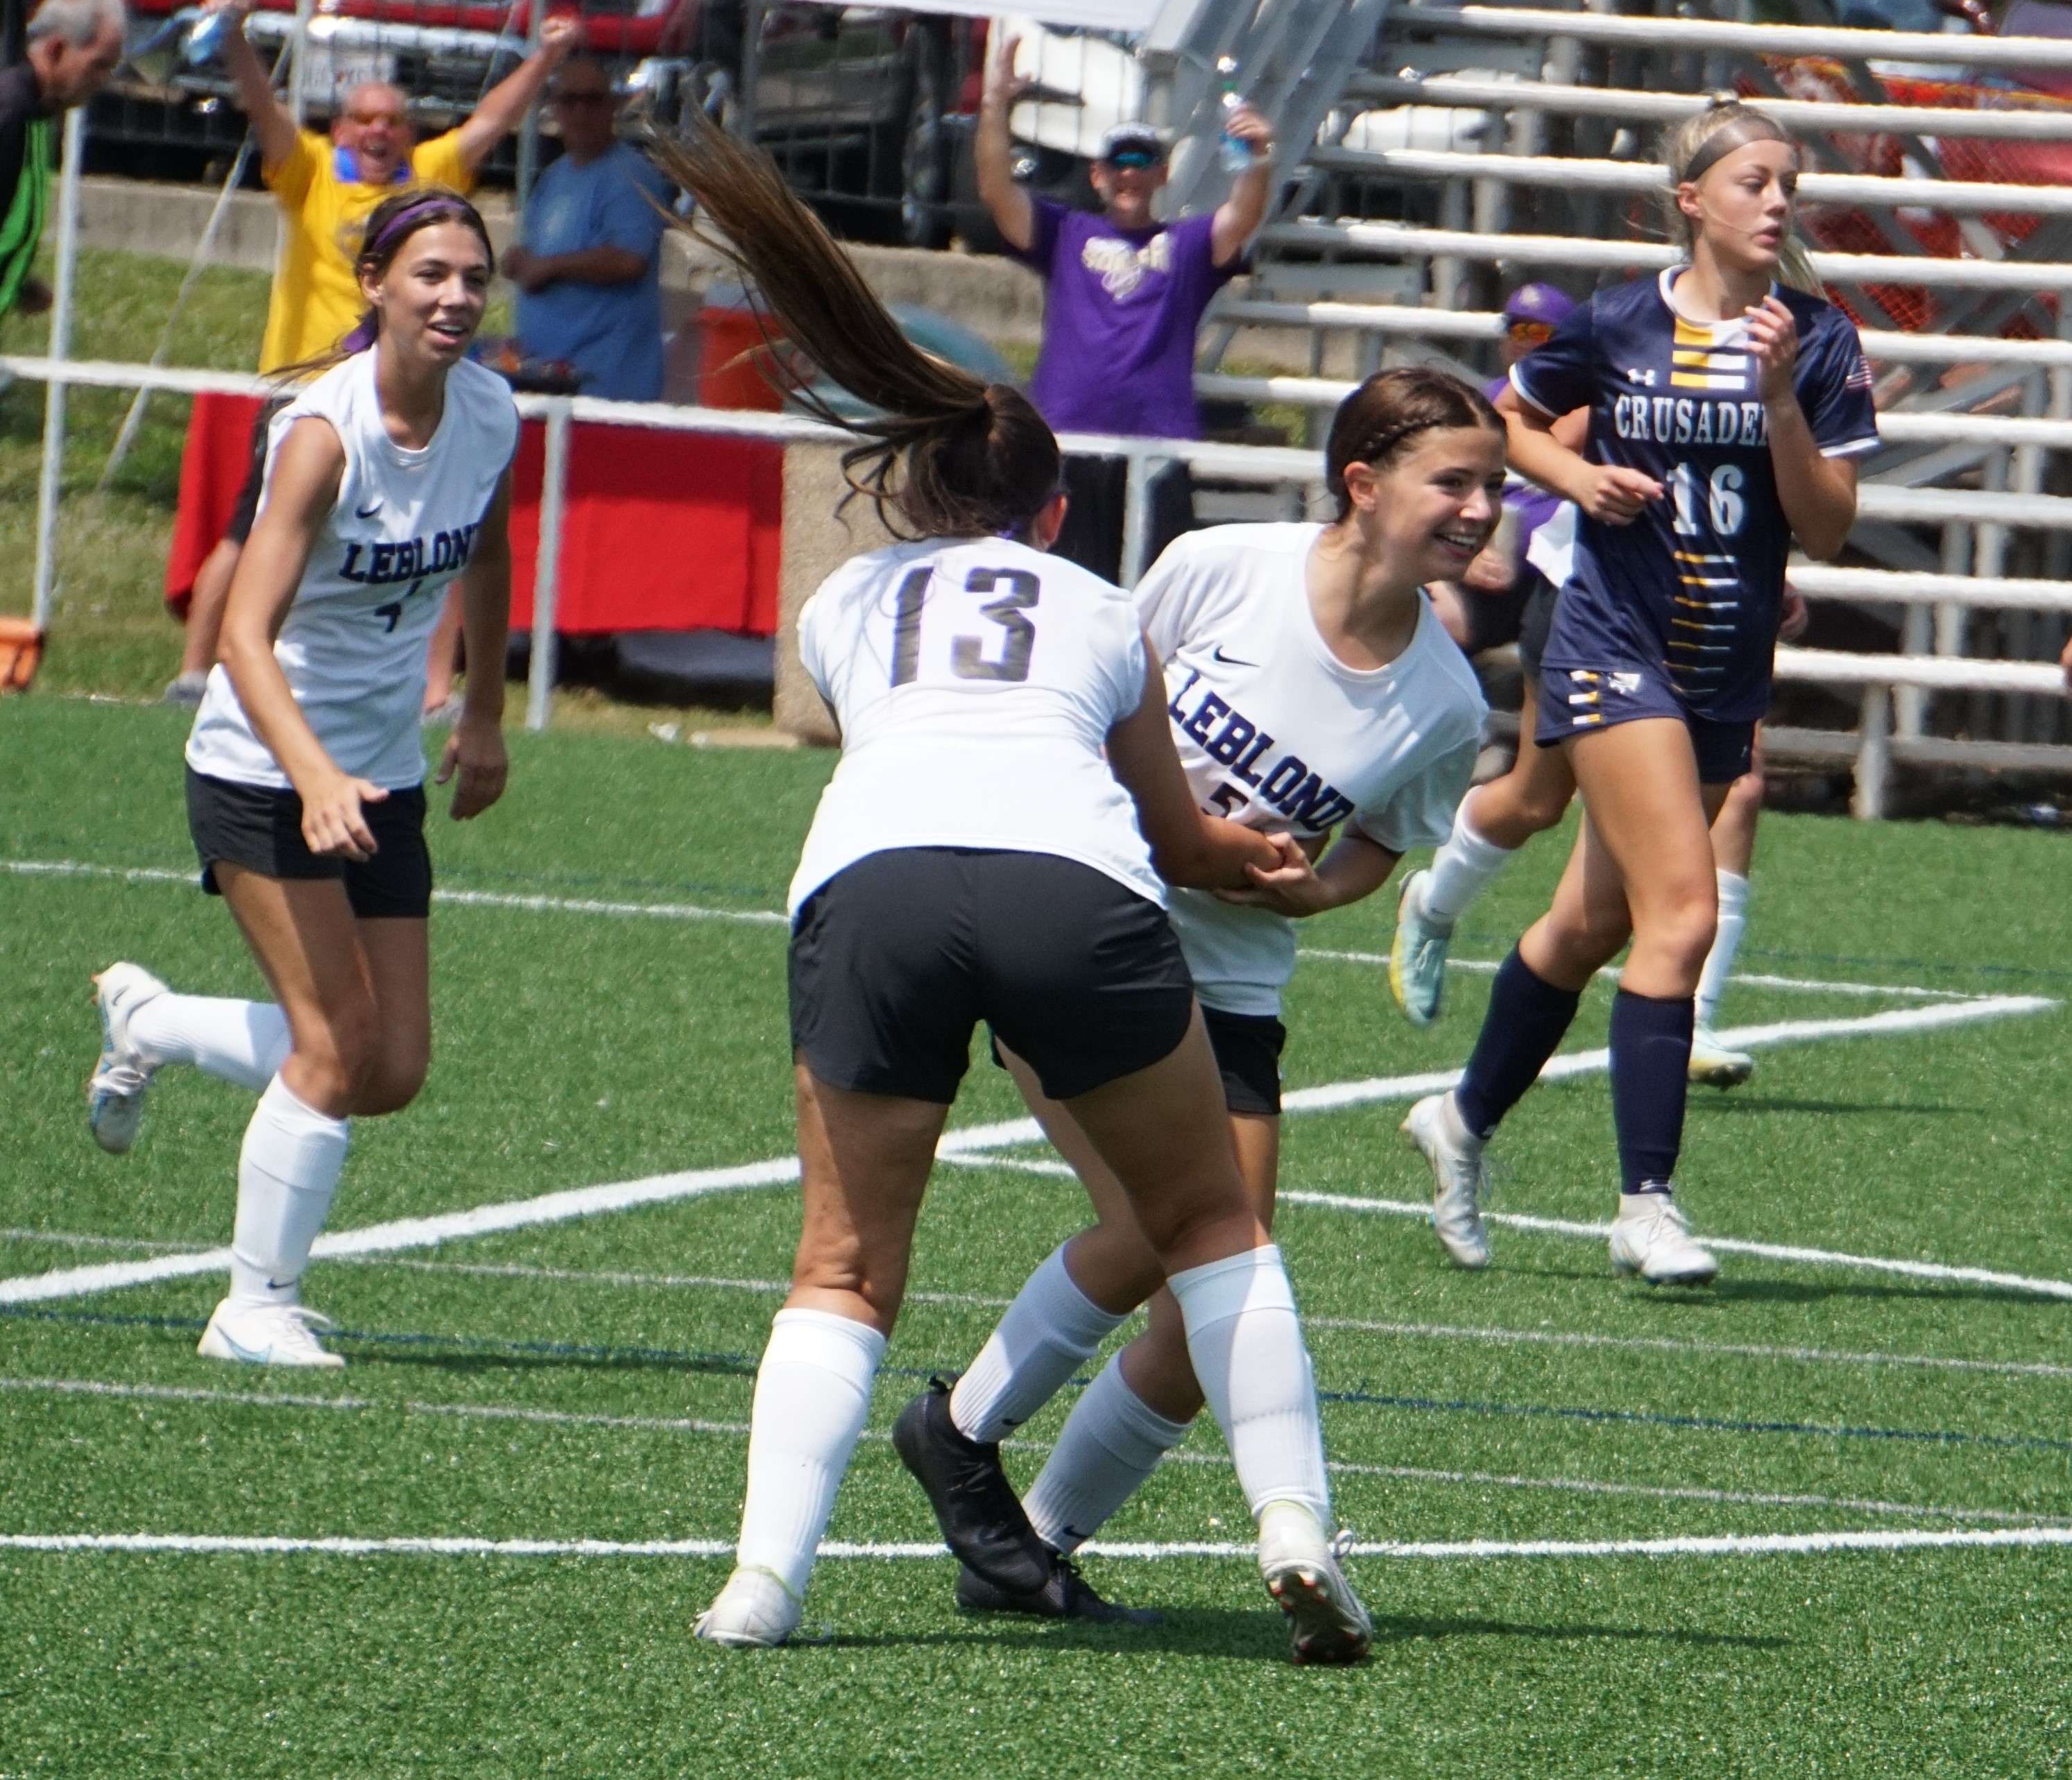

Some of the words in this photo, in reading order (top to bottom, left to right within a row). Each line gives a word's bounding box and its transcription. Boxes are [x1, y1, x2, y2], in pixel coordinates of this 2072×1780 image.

[1666, 462, 1744, 536] 16
[339, 522, 484, 584] LEBLON
[890, 566, 1041, 688] 13
[1168, 669, 1355, 832] LEBLOND
